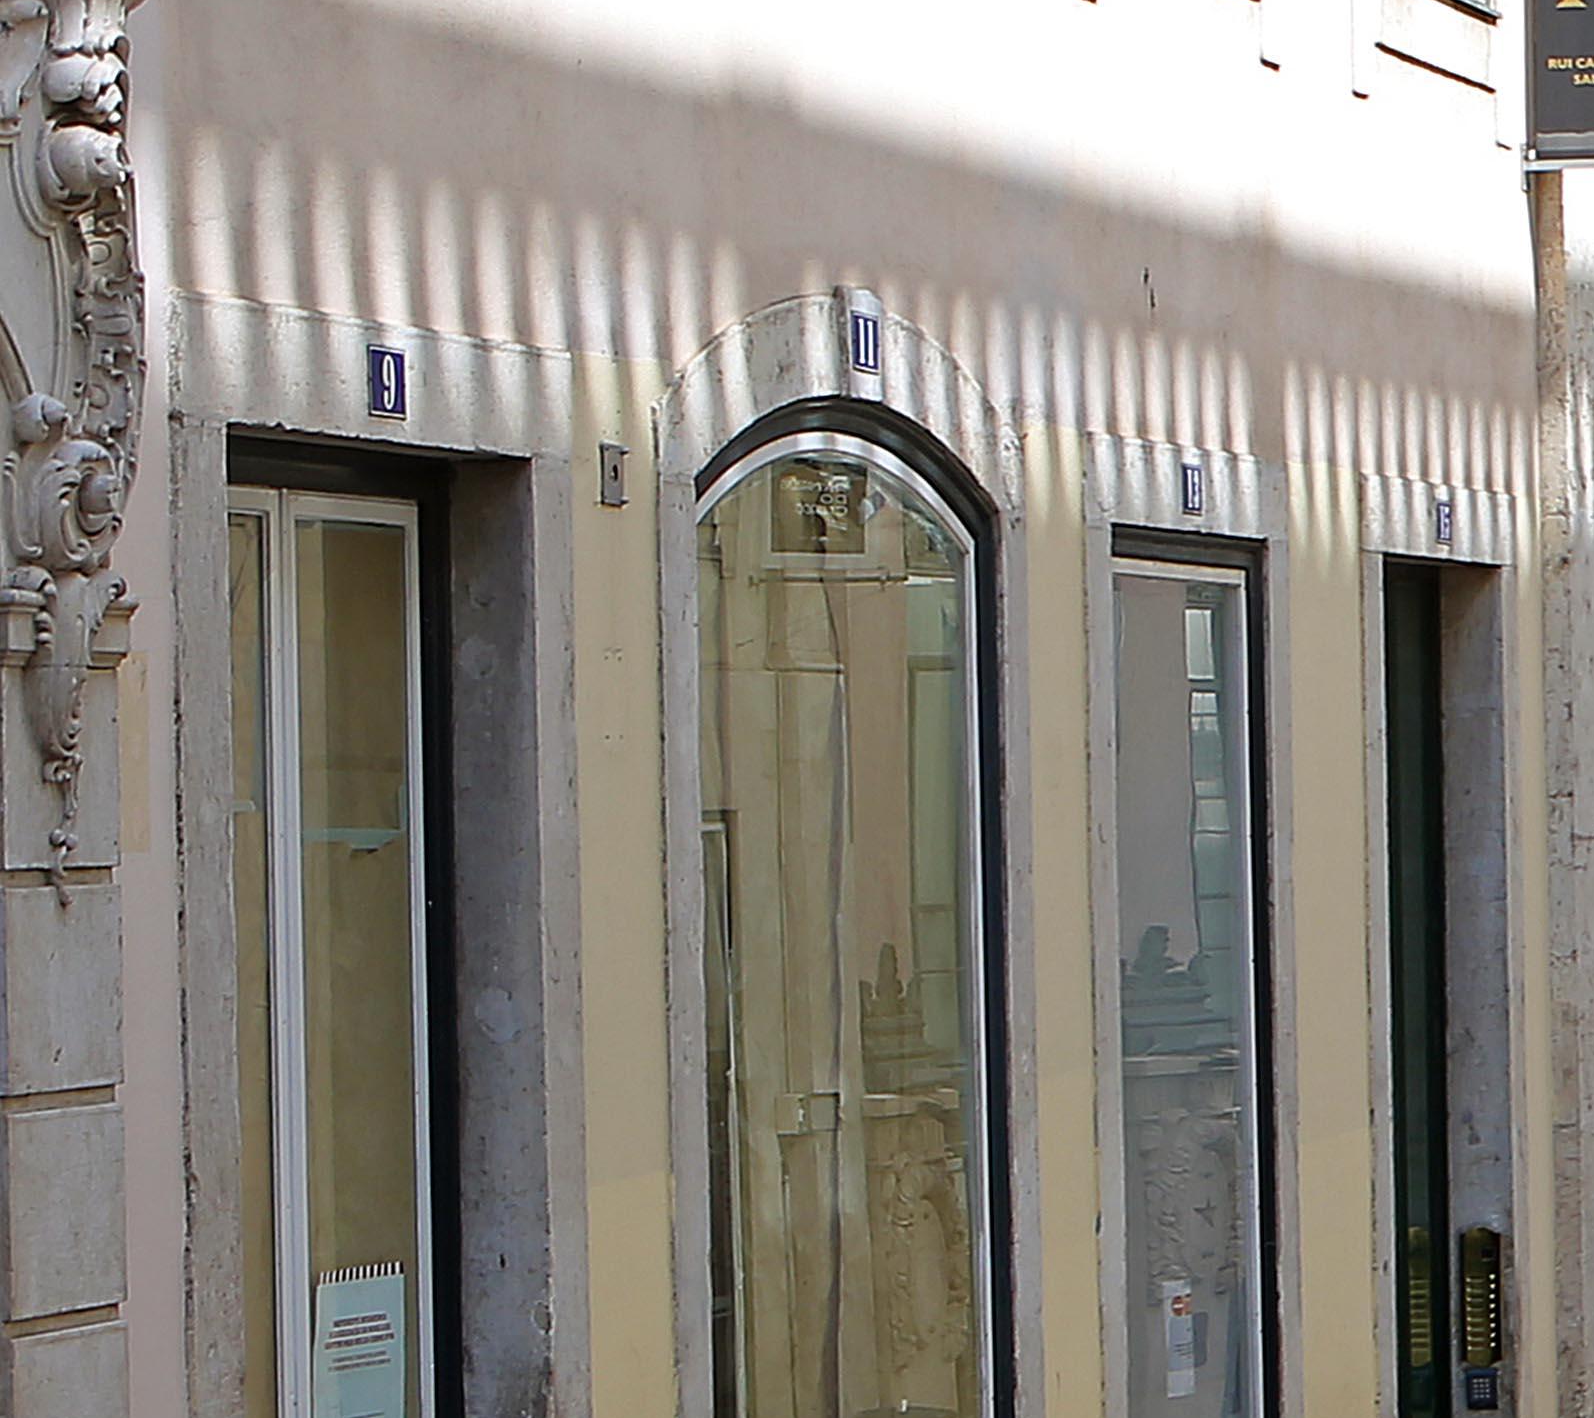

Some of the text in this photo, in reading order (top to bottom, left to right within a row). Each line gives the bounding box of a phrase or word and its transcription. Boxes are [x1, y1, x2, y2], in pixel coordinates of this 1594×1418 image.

[1547, 56, 1573, 69] RUI
[858, 317, 875, 367] 11
[382, 354, 395, 411] 9
[1186, 469, 1200, 510] 13
